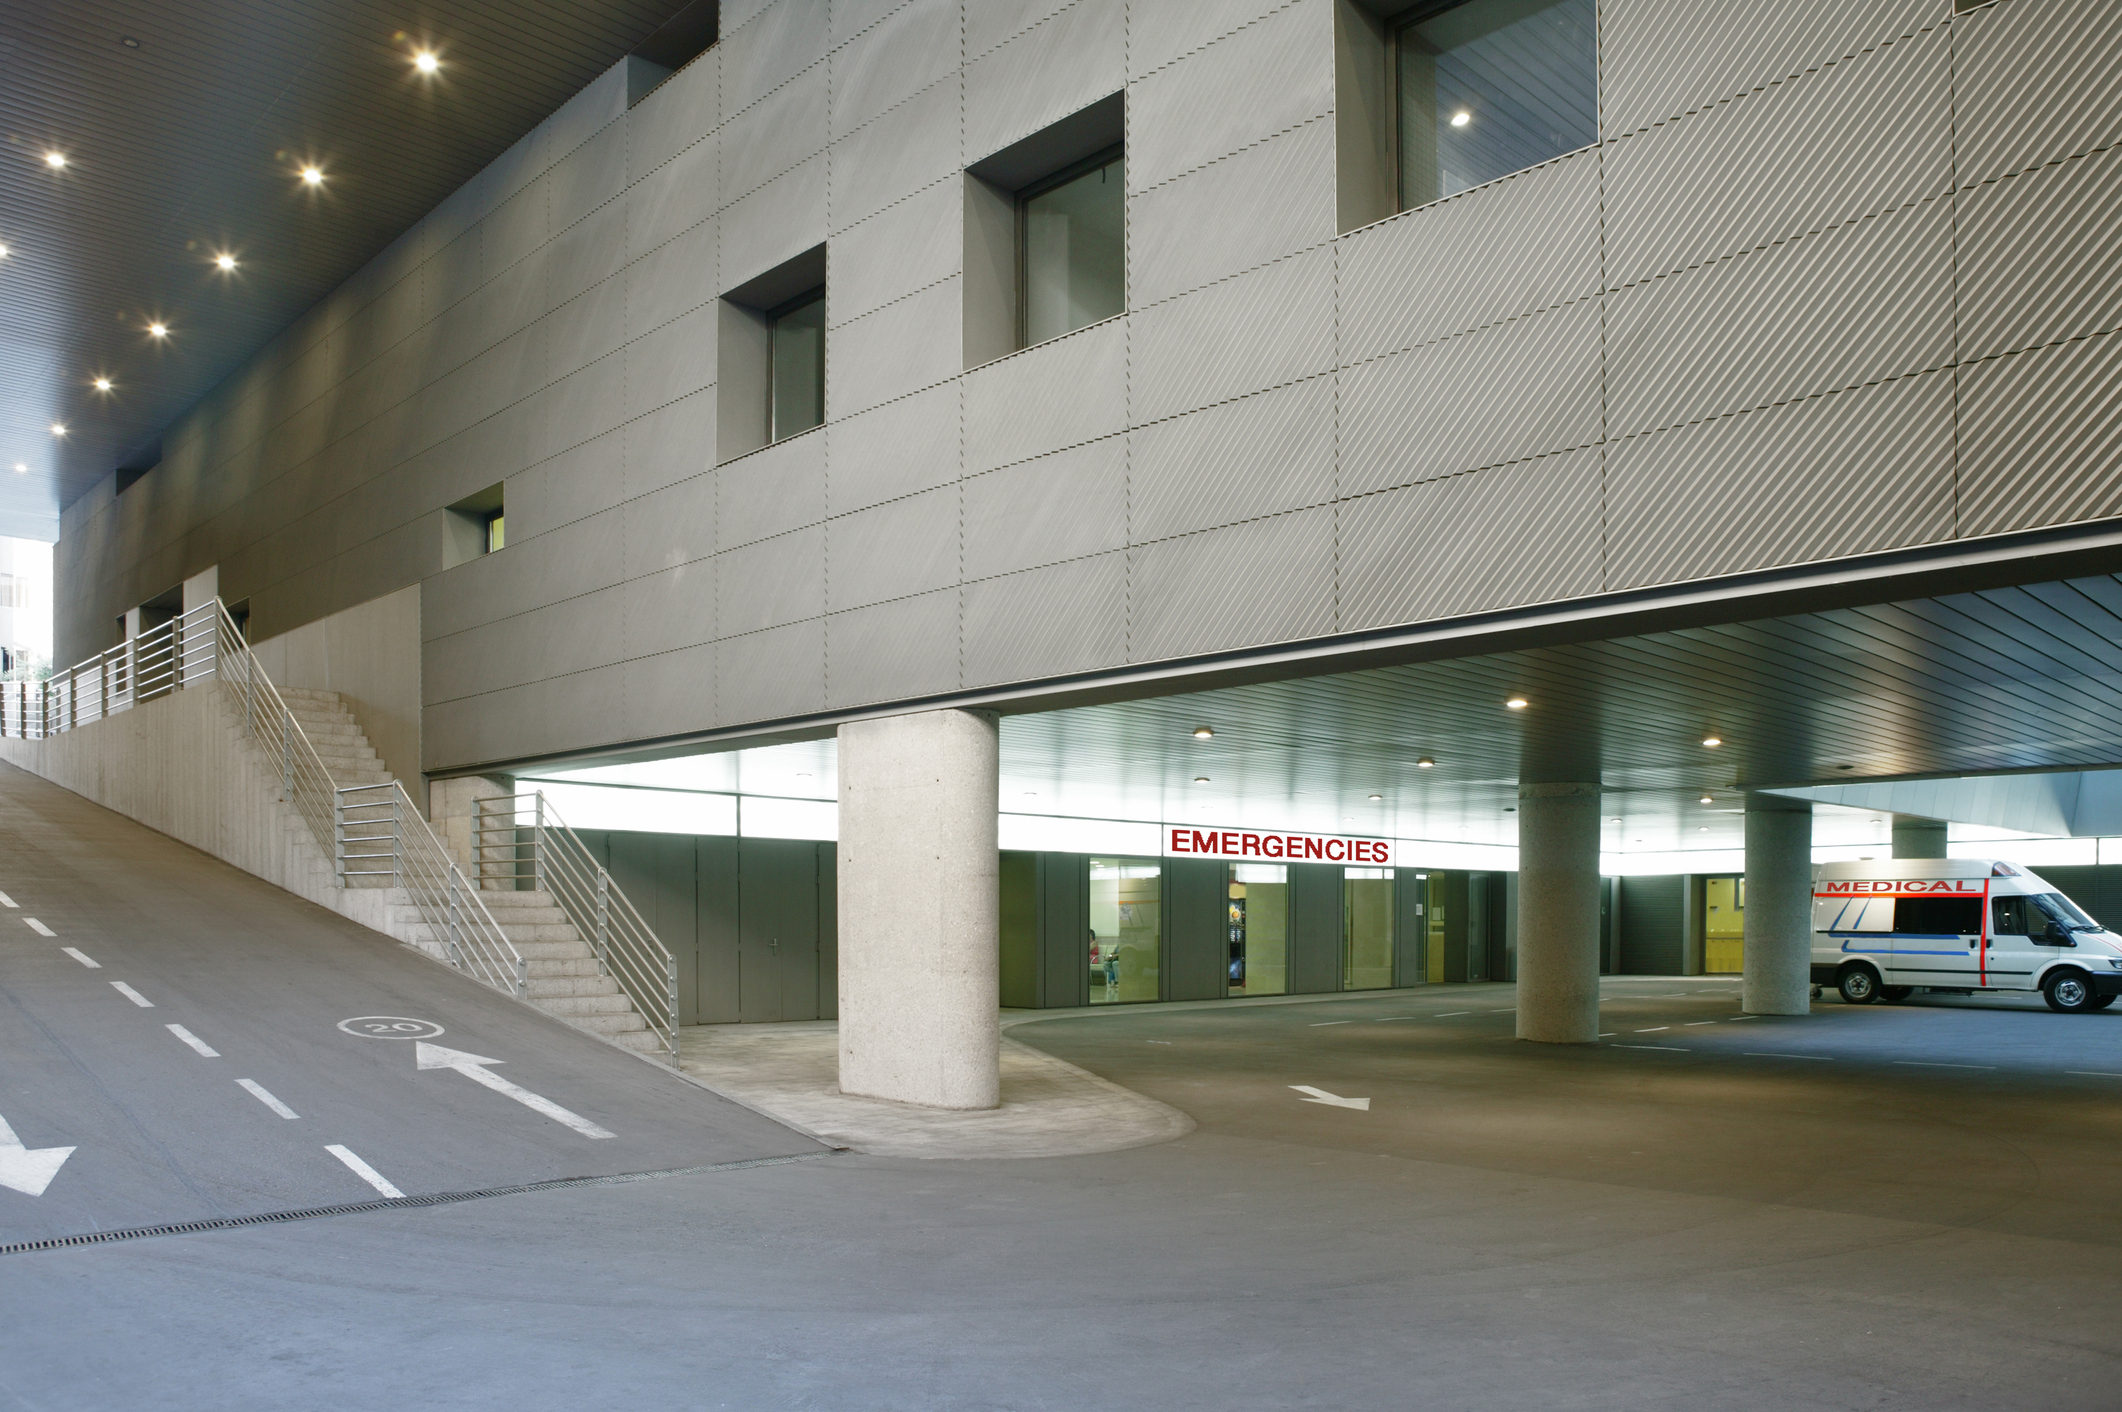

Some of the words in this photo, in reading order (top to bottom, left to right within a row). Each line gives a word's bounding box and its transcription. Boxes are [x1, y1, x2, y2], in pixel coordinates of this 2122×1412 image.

[1171, 829, 1389, 863] EMERGENCIES
[1826, 880, 1977, 892] MEDICAL
[364, 1023, 423, 1033] 20
